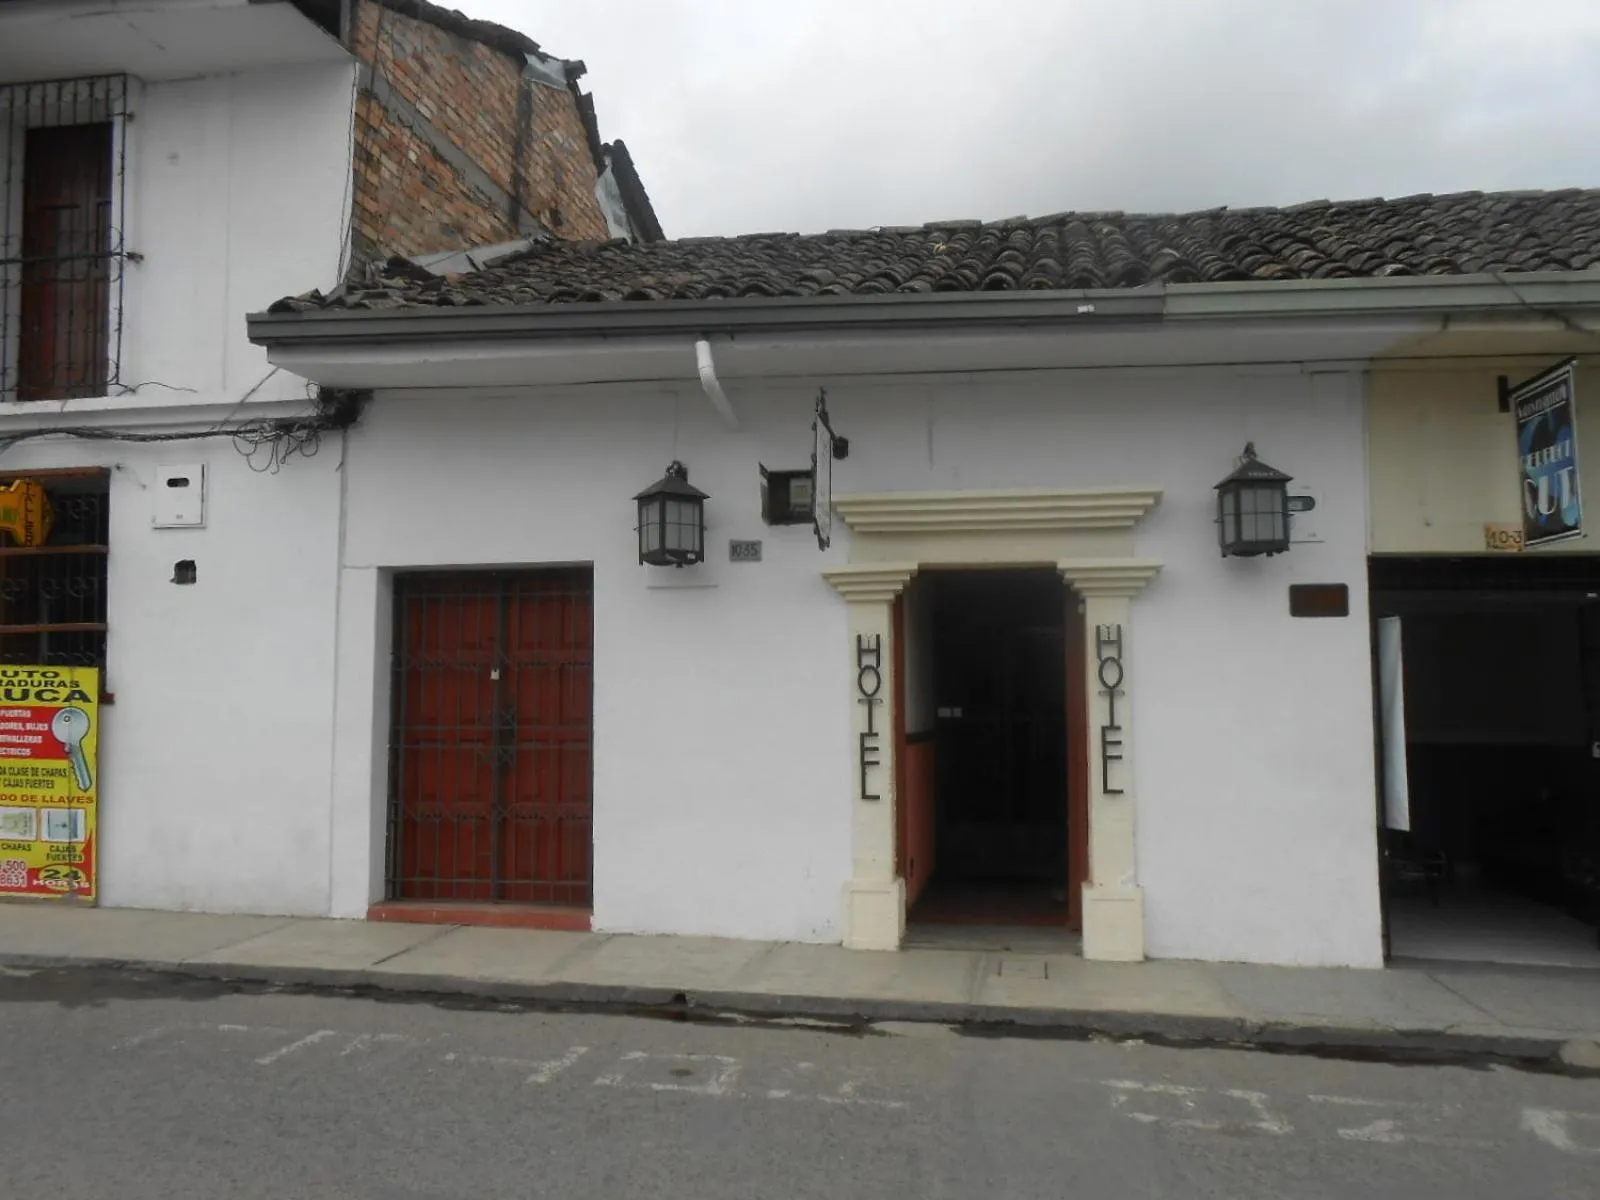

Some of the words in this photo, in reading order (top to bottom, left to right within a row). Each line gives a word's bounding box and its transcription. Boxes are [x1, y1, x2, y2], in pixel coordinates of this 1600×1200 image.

[0, 688, 93, 703] UCA
[1095, 624, 1126, 794] HOTEL
[856, 633, 884, 800] HOTEL
[8, 767, 29, 776] CLASE
[31, 767, 39, 776] DE
[20, 794, 38, 802] DE
[41, 795, 94, 804] LLAVES
[1, 843, 32, 851] CHAPAS
[43, 869, 82, 880] 24
